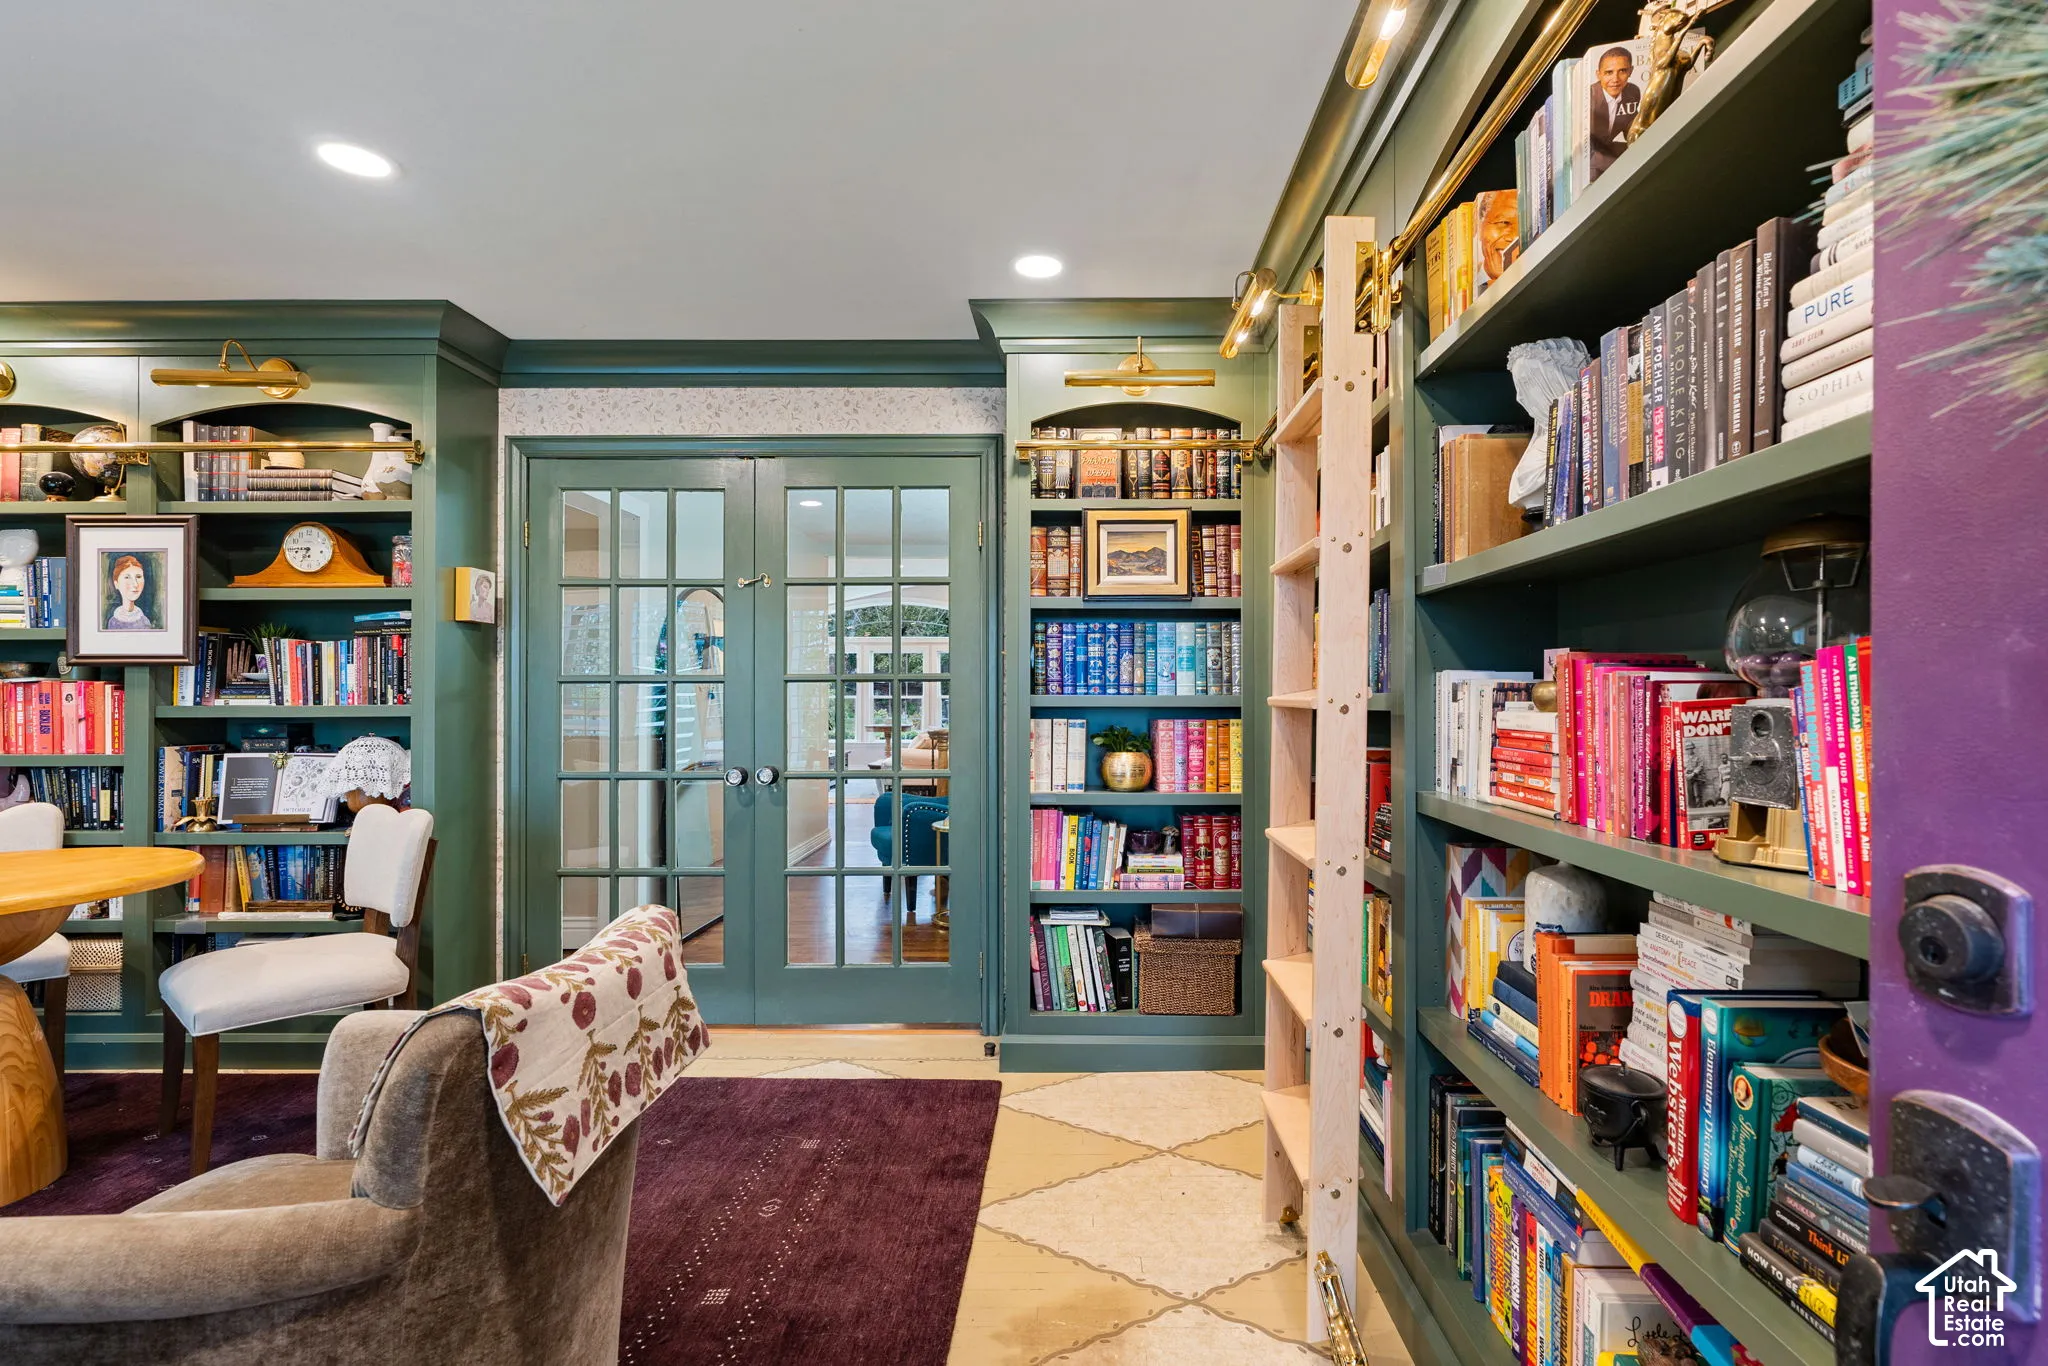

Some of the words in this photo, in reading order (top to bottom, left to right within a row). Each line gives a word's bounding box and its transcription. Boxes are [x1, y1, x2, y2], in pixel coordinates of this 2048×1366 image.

[1763, 252, 1772, 275] Black
[1763, 277, 1772, 297] Man
[1805, 285, 1854, 323] PURE
[1653, 315, 1662, 340] AMY
[1734, 313, 1742, 327] THE
[1734, 328, 1742, 348] DARK
[1807, 329, 1824, 343] STEIN
[1674, 313, 1685, 396] CAROLE
[1653, 346, 1663, 403] POEHLER
[1733, 357, 1741, 391] MICHELLE
[1798, 370, 1863, 405] SOPHIA
[1582, 375, 1591, 417] UNTAMED
[1619, 373, 1627, 444] CLEOPATRA
[1653, 407, 1664, 425] YES
[1675, 407, 1685, 459] KING
[1081, 456, 1117, 465] PHANTOM
[1583, 421, 1591, 462] GLENNON
[1653, 426, 1664, 462] PLEASE
[1086, 469, 1111, 477] OPERA
[1583, 463, 1591, 491] DOYLE
[1847, 655, 1857, 672] AN
[204, 670, 212, 698] SYMBOLS
[1849, 674, 1860, 732] ETHIOPIAN
[39, 709, 50, 735] BACKLASH
[1823, 701, 1832, 743] SELF-LOVE
[1832, 667, 1845, 749] ASSERTIVENESS
[1802, 748, 1810, 777] OBAMA
[1806, 716, 1822, 782] ROBINSON
[1838, 751, 1848, 784] GUIDE
[1854, 735, 1865, 781] ODYSSEY
[1843, 799, 1852, 839] WOMEN
[1649, 943, 1671, 957] ANATOMY
[1681, 956, 1697, 969] PEACE
[1041, 971, 1050, 996] BLOOM
[1633, 1015, 1642, 1025] the
[1642, 1019, 1657, 1034] signal
[1645, 1012, 1660, 1024] silver
[1703, 1038, 1718, 1118] Elementary
[1667, 1038, 1683, 1172] Webster's
[1677, 1094, 1688, 1162] Merriam-
[1701, 1119, 1714, 1193] Dictionary
[1736, 1113, 1758, 1182] Illustrated
[1735, 1180, 1751, 1222] Stories
[1496, 1218, 1504, 1307] PHILOSOPHY
[1771, 1234, 1800, 1259] TAKE
[1802, 1256, 1825, 1282] THE
[1807, 1229, 1834, 1258] Think
[1511, 1243, 1520, 1307] FEMINISM
[1747, 1246, 1769, 1269] HOW
[1770, 1265, 1784, 1281] TO
[1785, 1277, 1799, 1295] BE
[1526, 1257, 1537, 1353] PSYCHOLOGY
